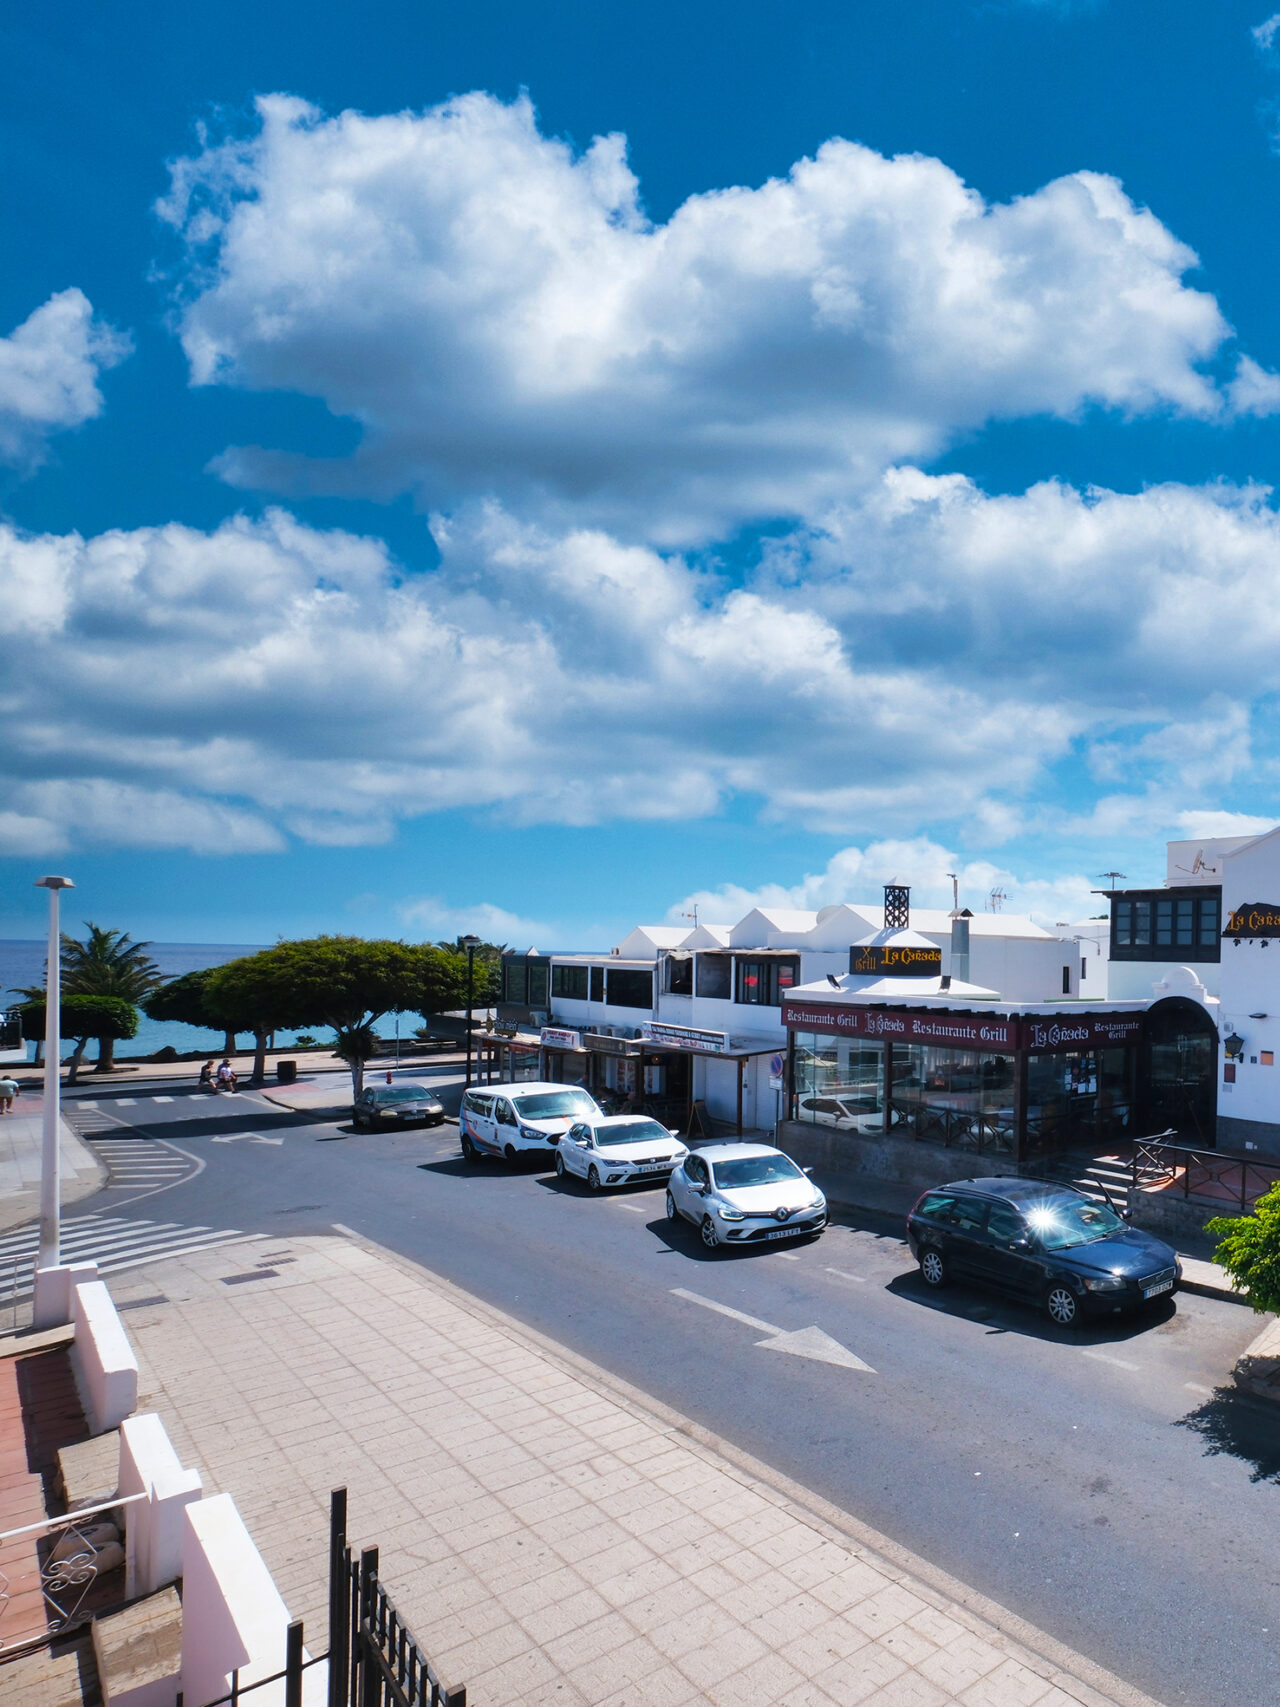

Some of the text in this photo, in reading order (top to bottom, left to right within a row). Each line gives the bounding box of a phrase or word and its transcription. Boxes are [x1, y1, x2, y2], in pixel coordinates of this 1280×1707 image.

[1227, 910, 1244, 931] La
[855, 956, 876, 972] Grill
[881, 947, 899, 965] La
[787, 1009, 835, 1025] Restaurante
[837, 1013, 859, 1028] Grill
[912, 1020, 977, 1040] Restaurante
[980, 1024, 1008, 1042] Grill
[1094, 1021, 1140, 1033] Restaurante
[1030, 1023, 1047, 1048] La
[1108, 1030, 1127, 1040] Grill
